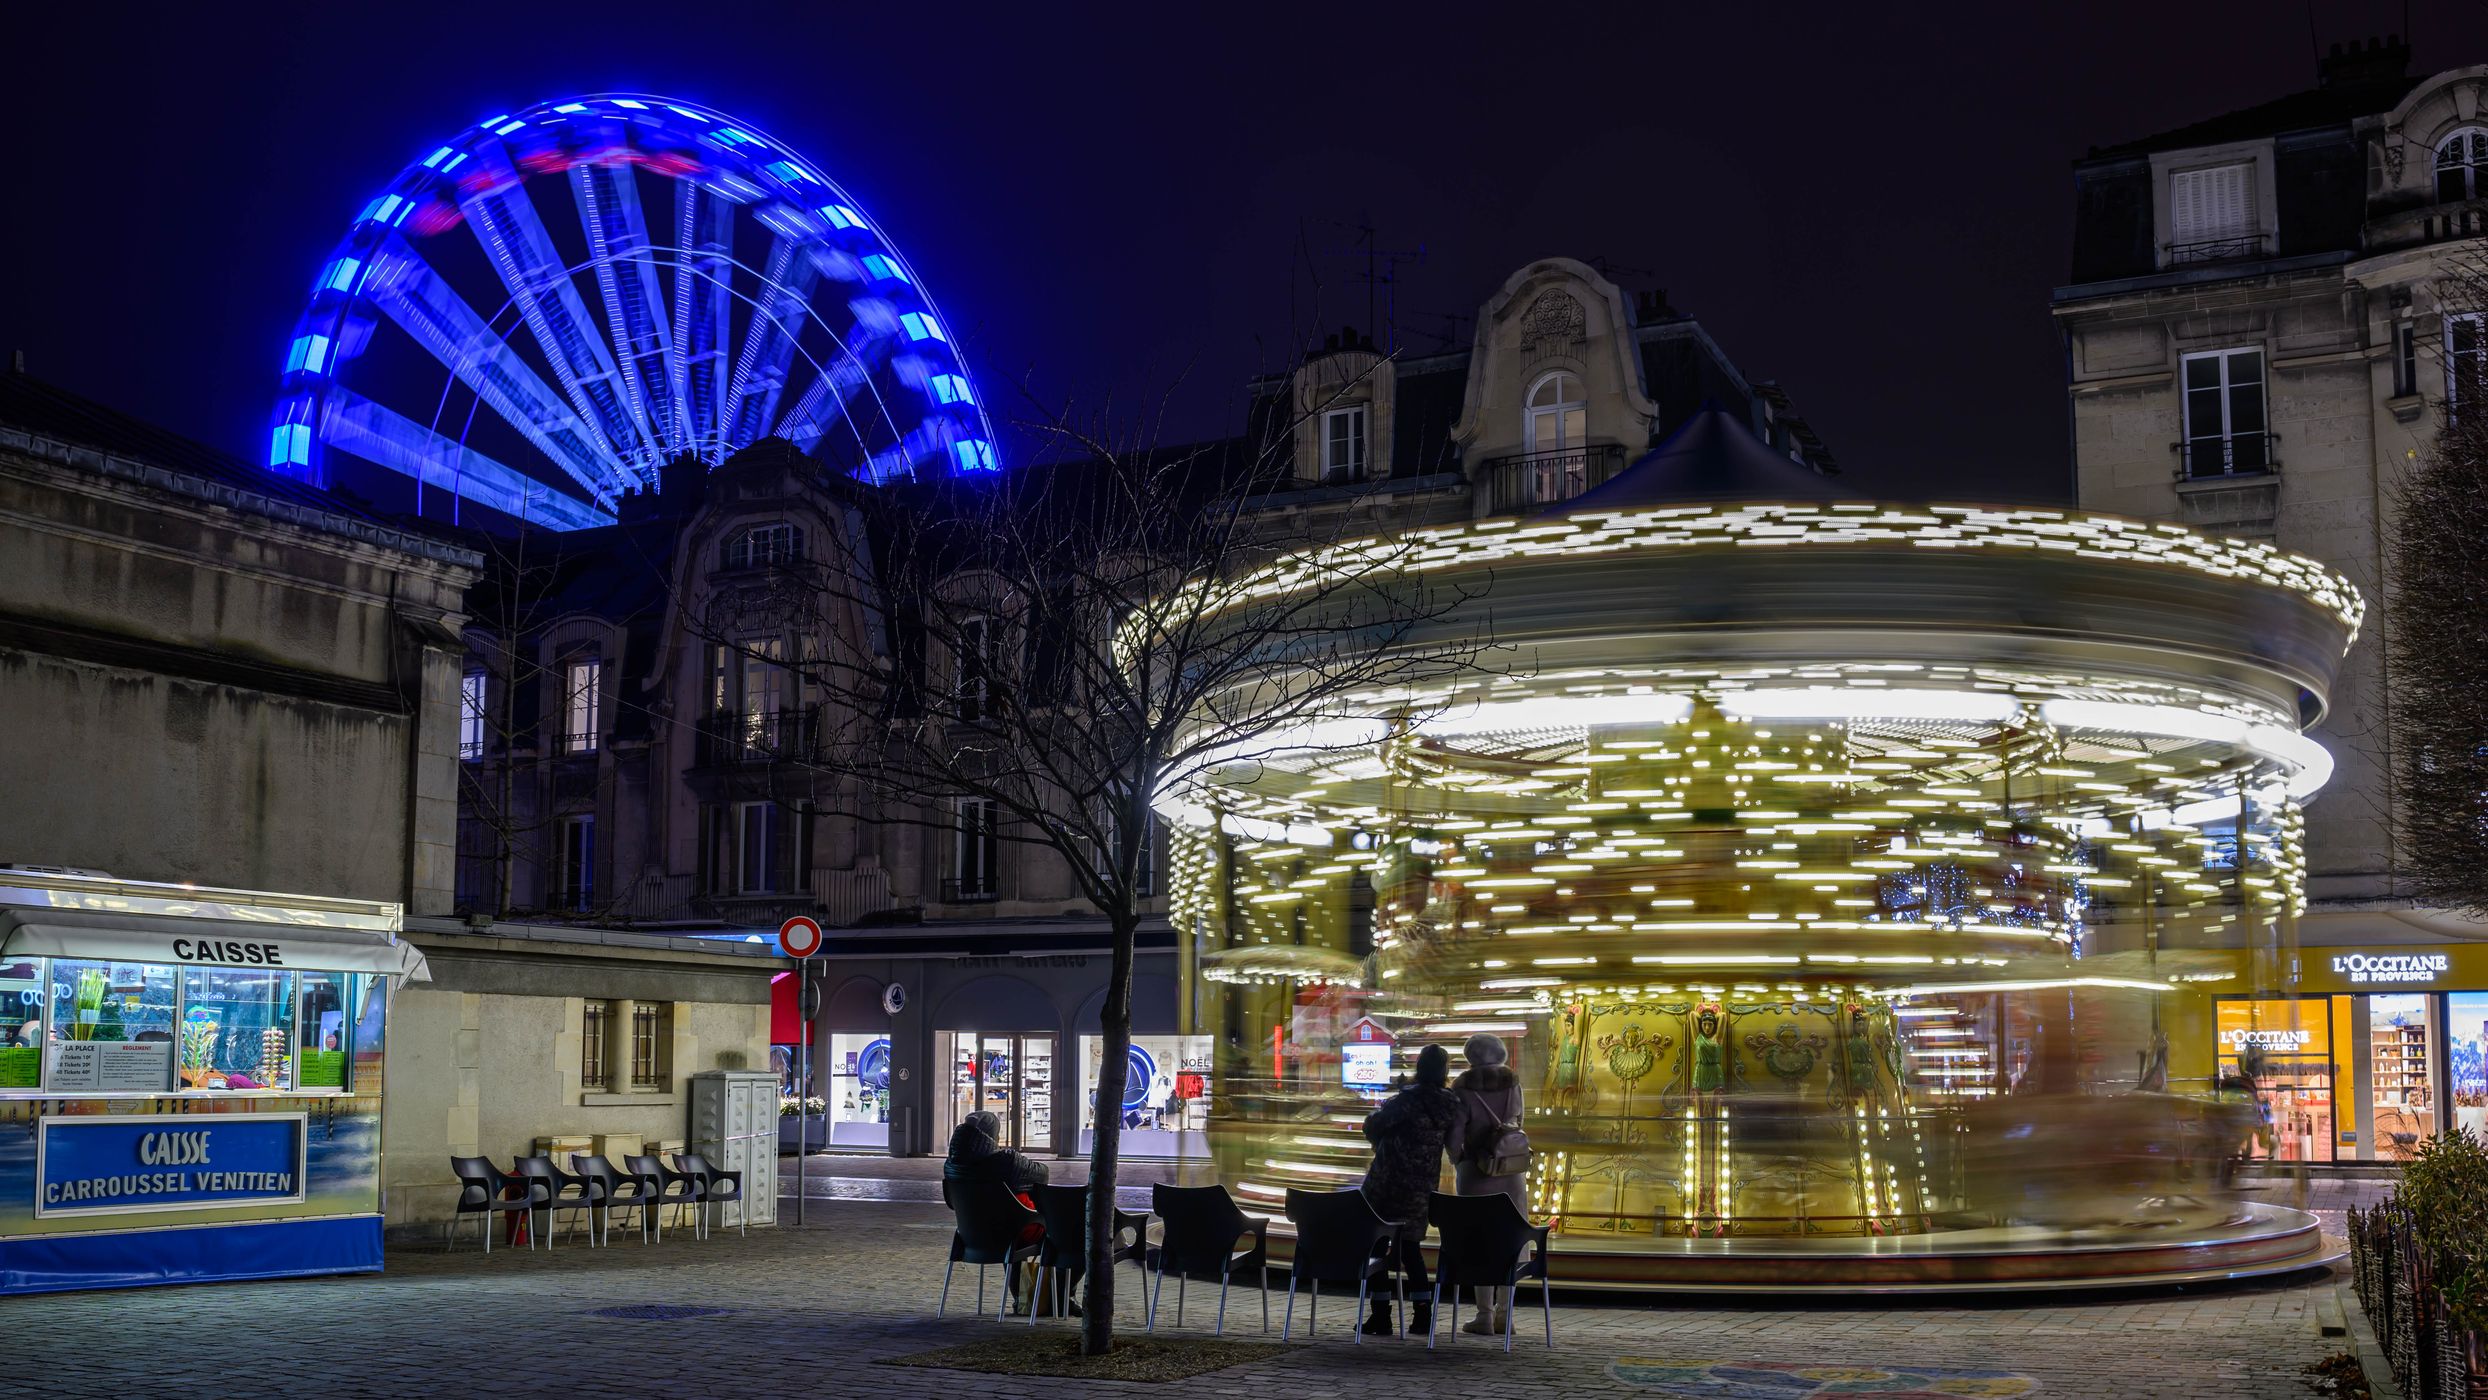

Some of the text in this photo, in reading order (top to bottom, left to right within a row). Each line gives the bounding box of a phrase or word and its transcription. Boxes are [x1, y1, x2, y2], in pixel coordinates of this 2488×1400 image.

[173, 939, 283, 965] CAISSE
[2333, 954, 2448, 972] L'OCCITANE
[2351, 971, 2434, 982] EN PROVENCE
[2221, 1029, 2310, 1043] L'OCCITANE
[2234, 1043, 2247, 1051] EN
[1181, 1056, 1209, 1067] NOËL
[141, 1131, 212, 1166] CAISSE
[46, 1171, 291, 1204] CARROUSSEL VENITIEN
